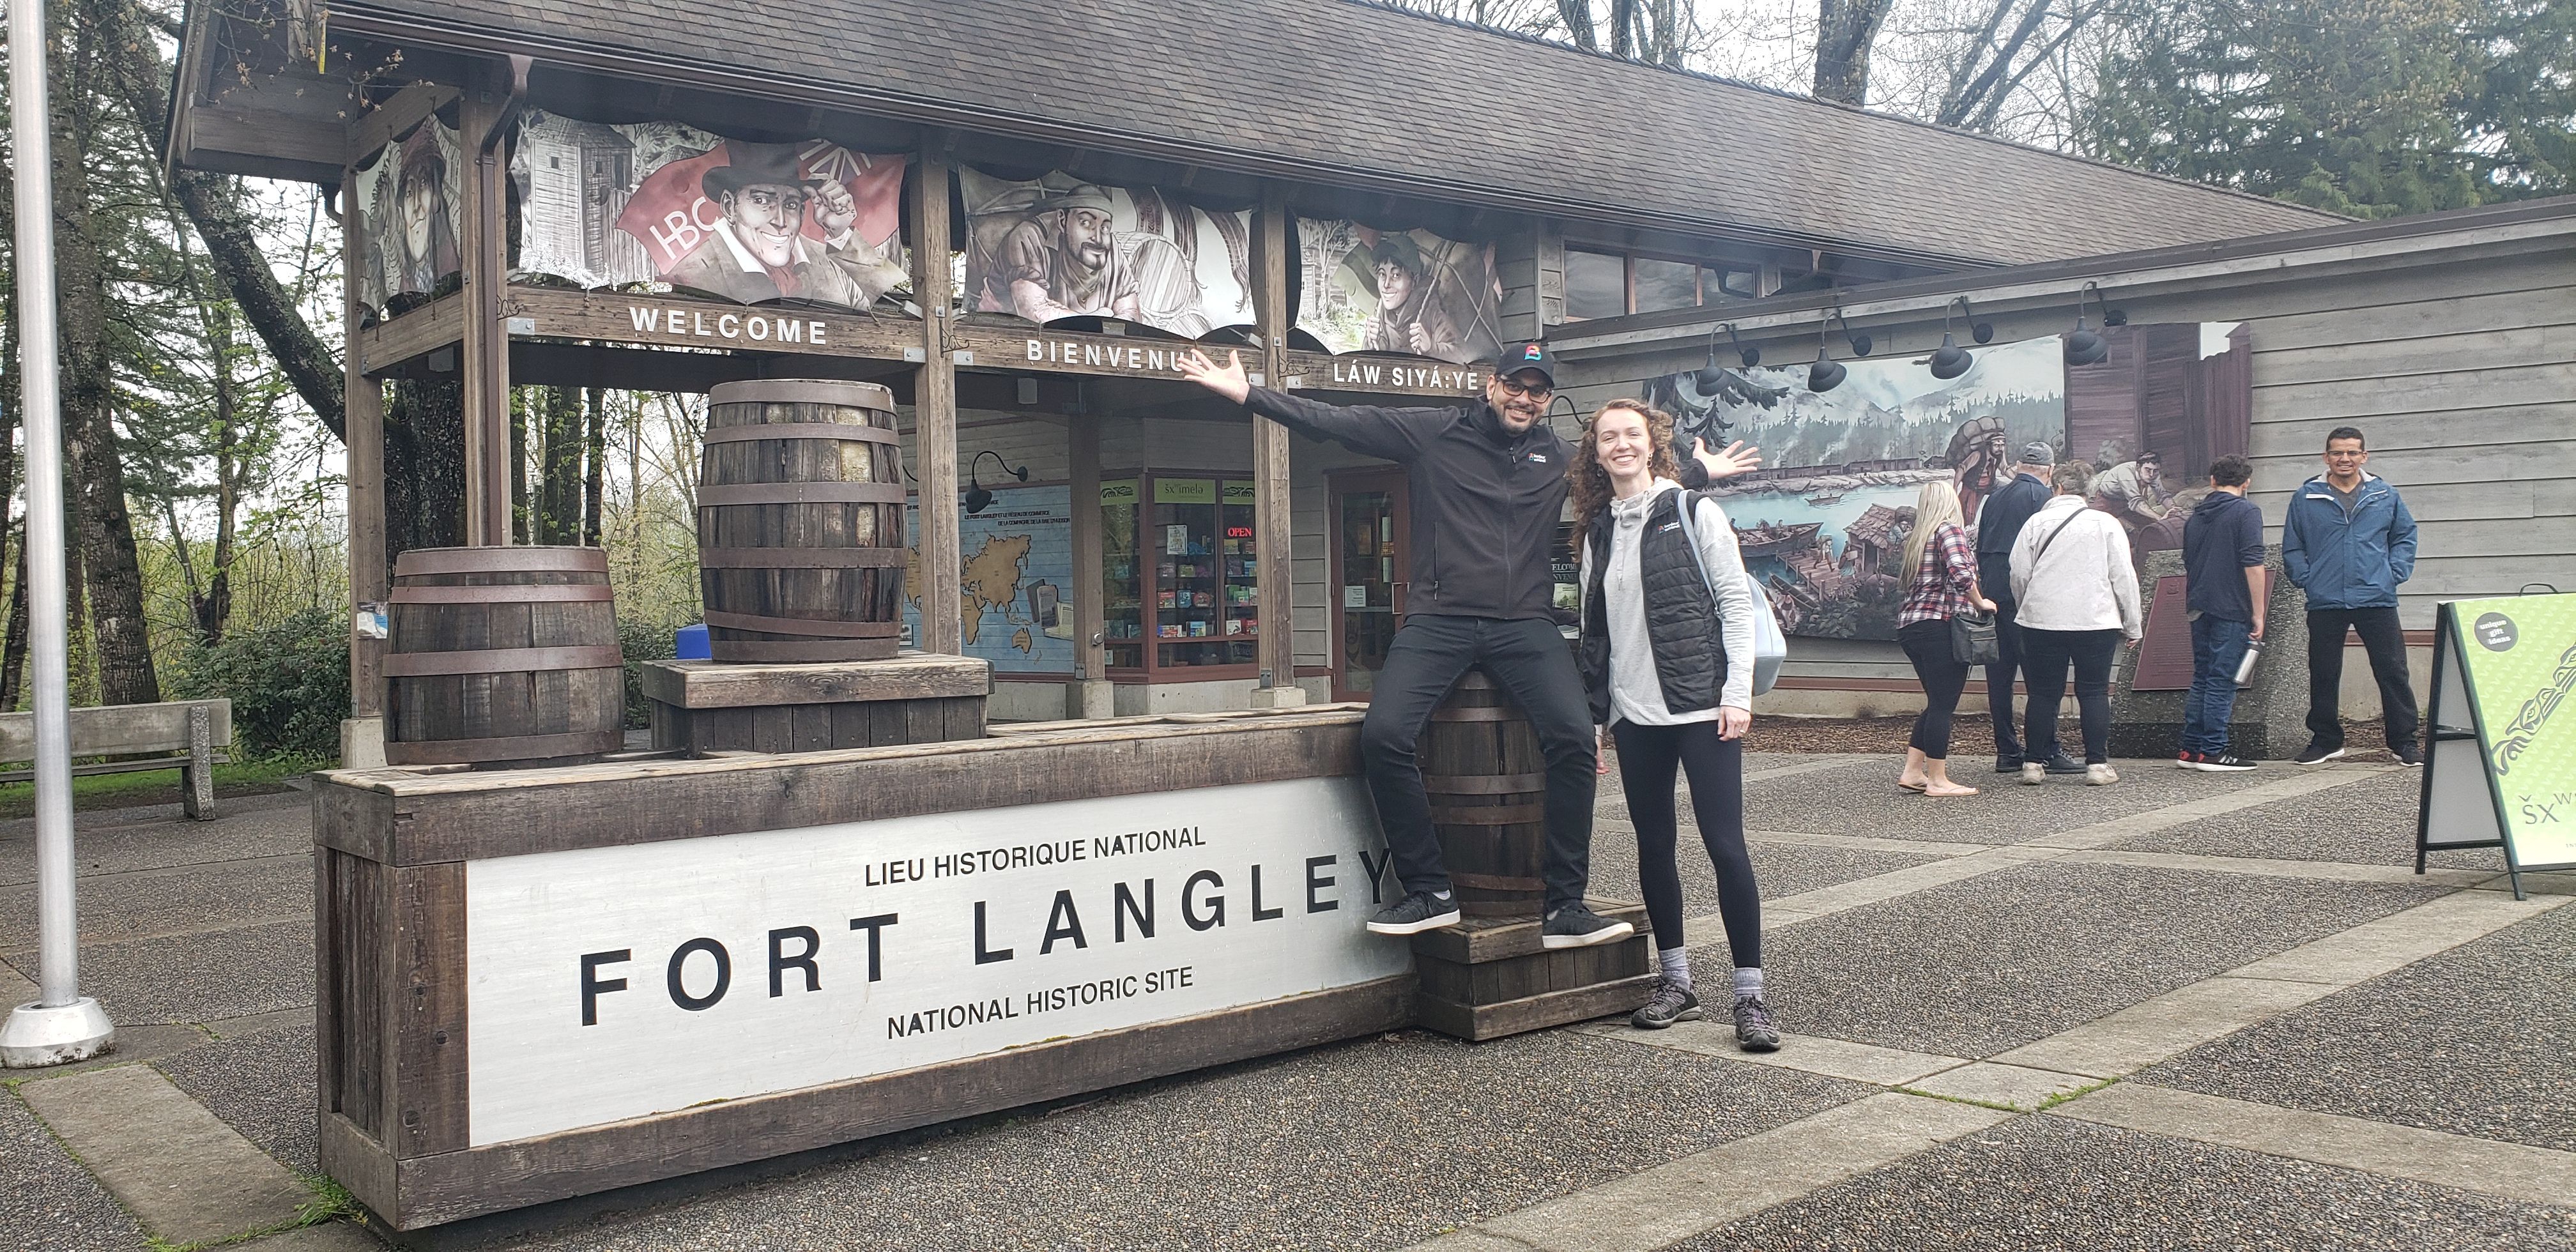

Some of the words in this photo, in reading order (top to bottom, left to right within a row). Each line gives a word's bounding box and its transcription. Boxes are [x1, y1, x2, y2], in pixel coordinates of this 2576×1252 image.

[649, 196, 719, 261] HBC
[629, 307, 826, 345] WELCOME
[1334, 359, 1380, 385] LÁW
[1392, 365, 1478, 390] SIYÁ:YE
[1227, 527, 1252, 537] OPEN
[2480, 620, 2507, 630] unique
[2488, 636, 2511, 645] ideas
[2490, 628, 2504, 637] gift
[866, 858, 924, 887] LIEU
[935, 839, 1086, 878] HISTORIQUE
[1094, 826, 1206, 859] NATIONAL
[581, 912, 898, 1027] FORT
[974, 848, 1392, 965] LANGLEY
[888, 996, 1019, 1040] NATIONAL
[1027, 975, 1137, 1015] HISTORIC
[1145, 965, 1193, 994] SITE
